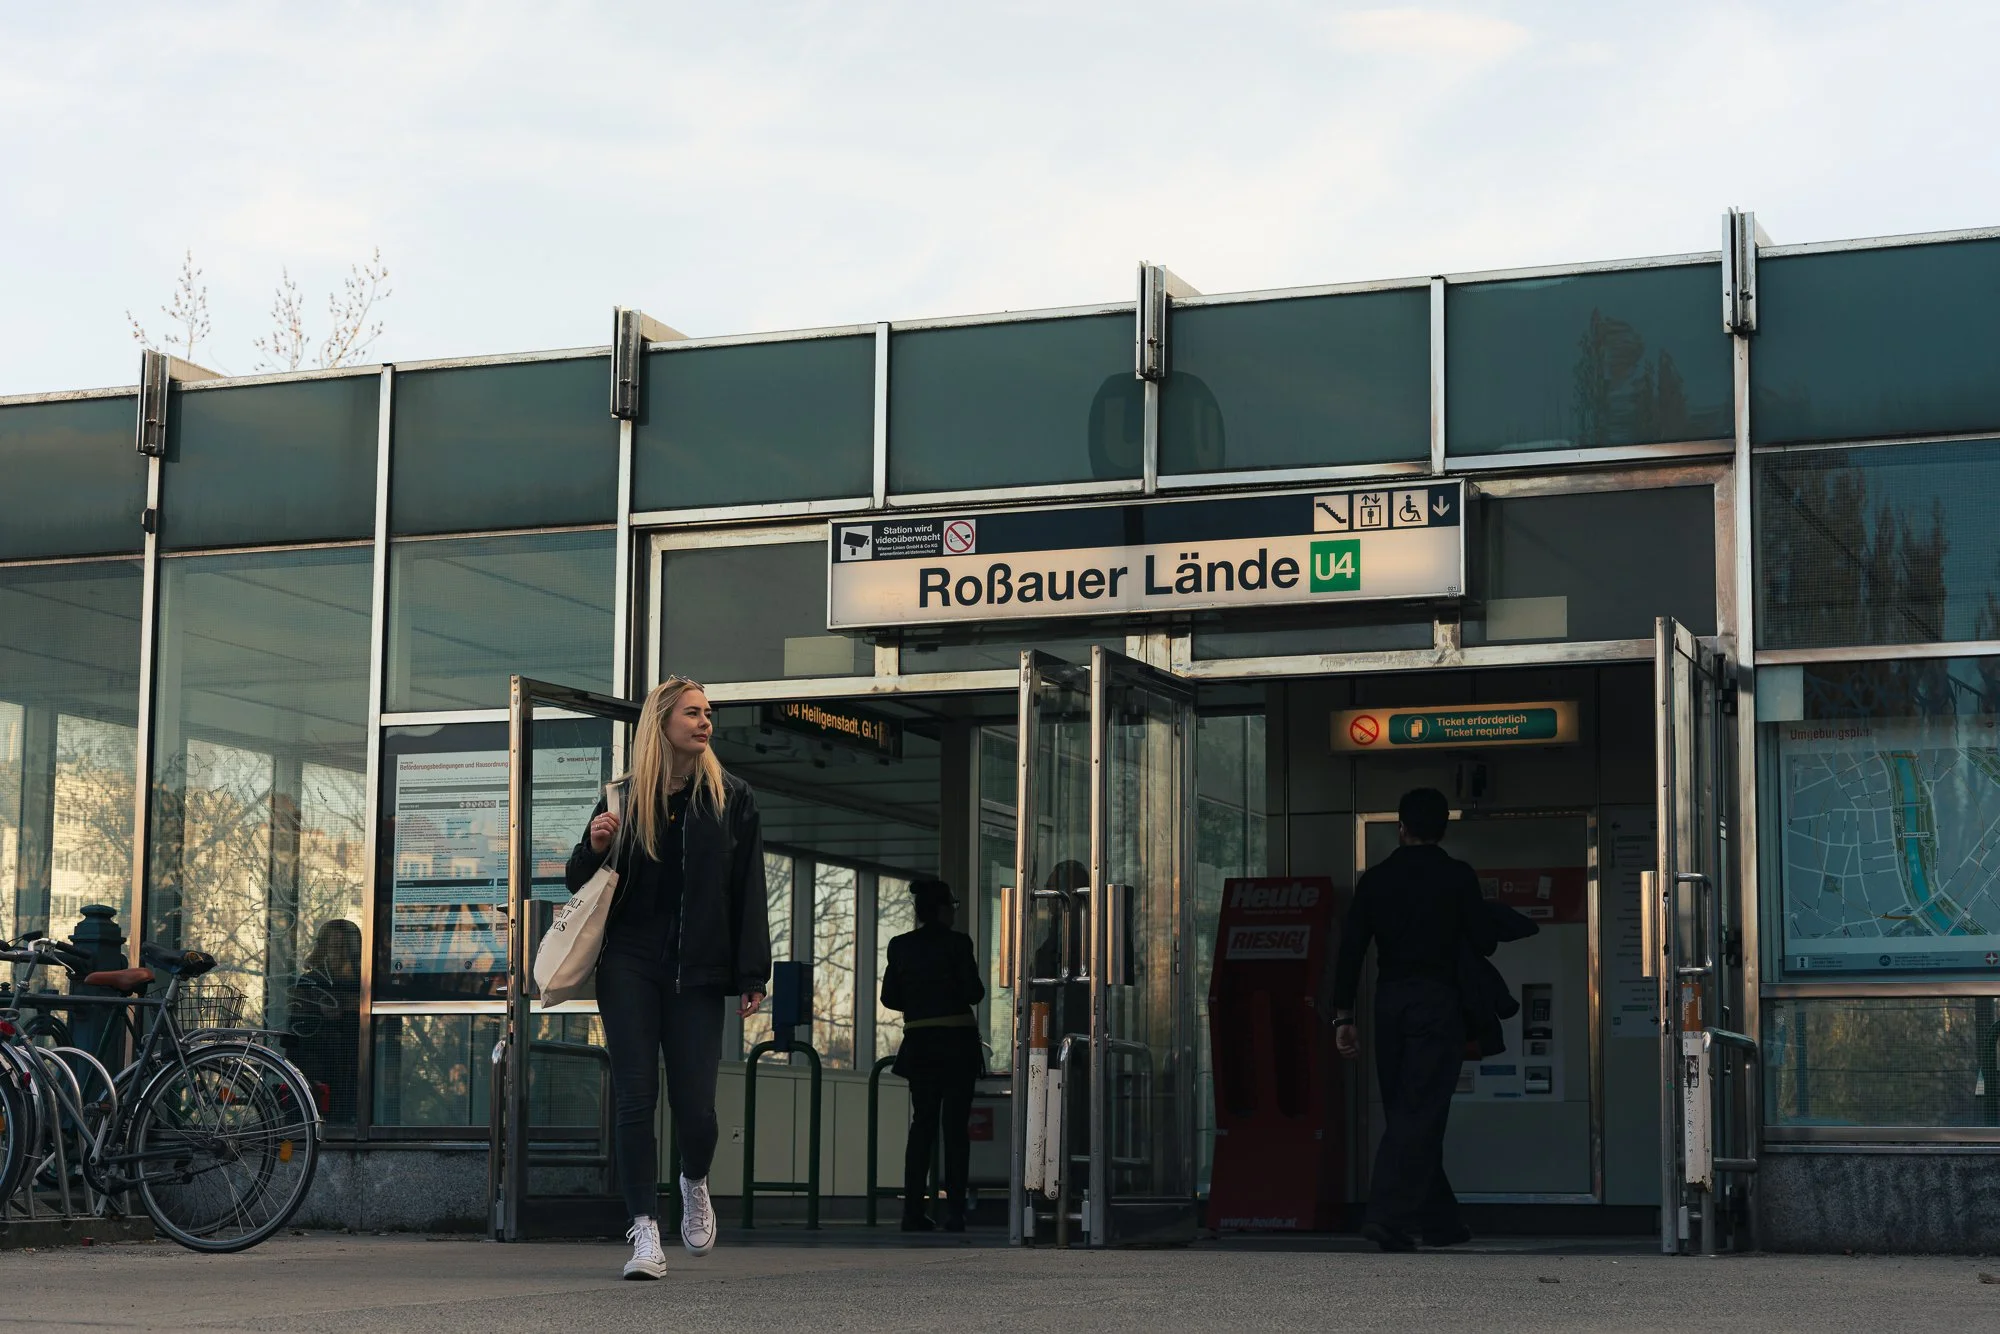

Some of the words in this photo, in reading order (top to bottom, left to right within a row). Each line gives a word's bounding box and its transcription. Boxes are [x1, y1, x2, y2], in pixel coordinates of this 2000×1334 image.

[883, 526, 912, 534] Station
[914, 524, 932, 532] wird
[875, 534, 940, 544] videoüberwacht
[919, 563, 1128, 608] Roßauer
[1145, 548, 1300, 595] Lände
[1315, 551, 1356, 581] U4
[802, 704, 860, 738] Heiligenstadt,
[1436, 717, 1465, 726] Ticket
[1467, 714, 1527, 725] erforderlich
[1445, 727, 1473, 737] Ticket
[1476, 726, 1518, 737] required
[1230, 882, 1320, 908] Heute
[1232, 930, 1307, 949] RIESIG!
[1220, 1216, 1297, 1228] www.heute.at
